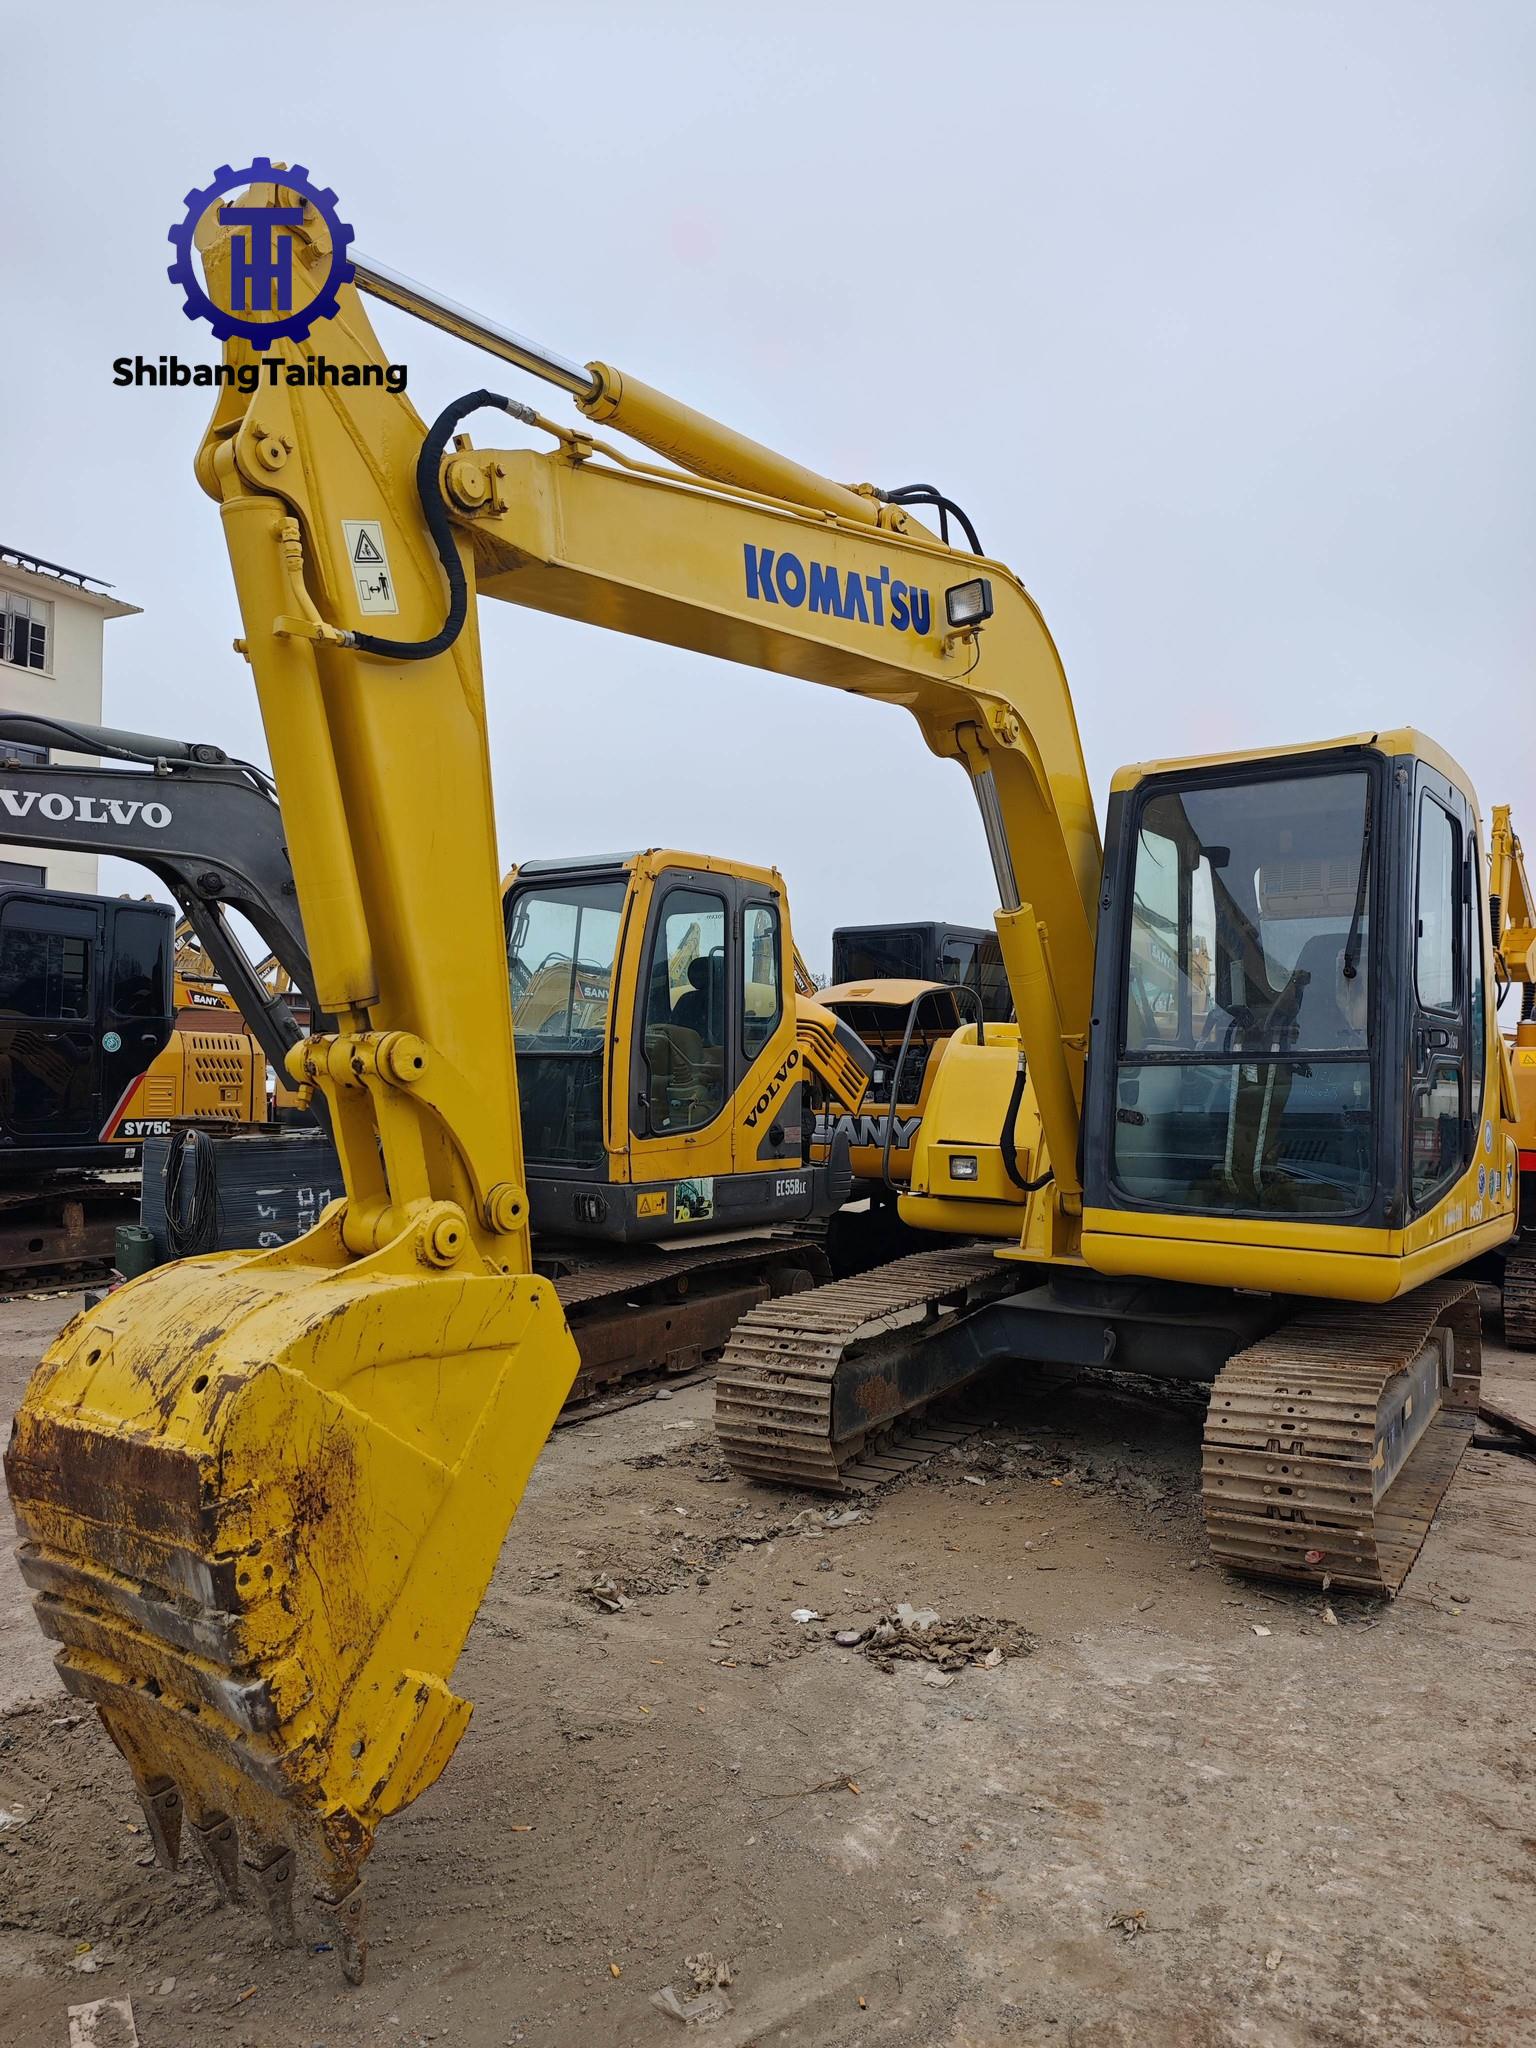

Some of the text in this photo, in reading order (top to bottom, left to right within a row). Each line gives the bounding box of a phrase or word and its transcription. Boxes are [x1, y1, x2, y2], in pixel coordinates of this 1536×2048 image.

[743, 543, 931, 636] KOMATSU
[0, 789, 173, 829] VOLVO
[193, 994, 218, 1006] SANY
[743, 1049, 799, 1128] VOLVO
[124, 1121, 171, 1136] SY75C
[811, 1113, 922, 1149] SANY
